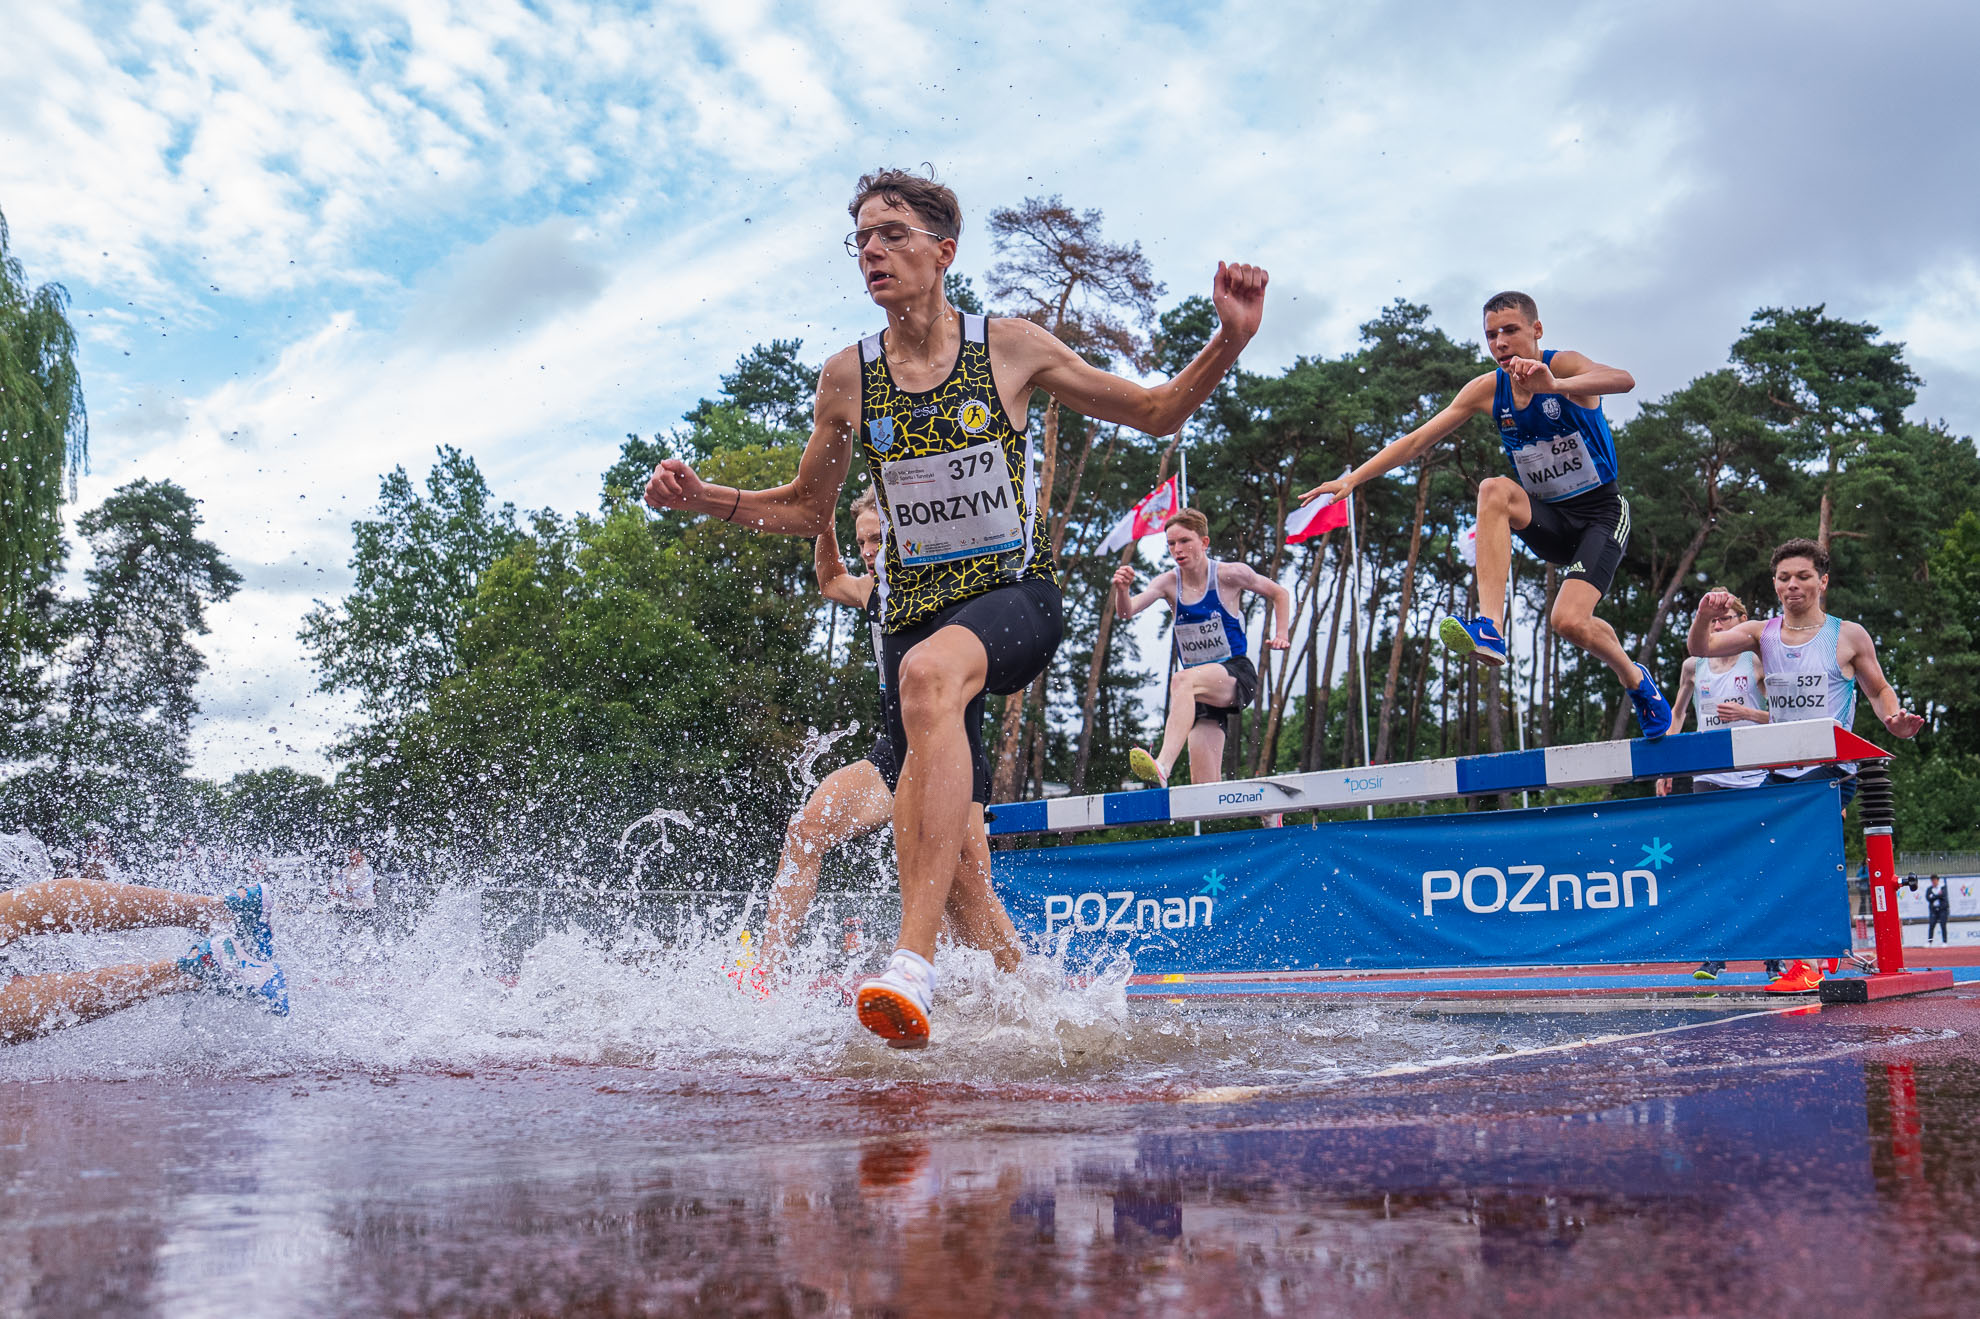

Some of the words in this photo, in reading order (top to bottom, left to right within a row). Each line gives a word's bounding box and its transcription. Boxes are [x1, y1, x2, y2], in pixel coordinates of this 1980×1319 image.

[1551, 438, 1578, 455] 628
[948, 451, 994, 480] 379
[1527, 457, 1582, 484] WALAS
[895, 485, 1008, 526] BORZYM
[1199, 622, 1218, 634] 829
[1182, 636, 1223, 651] NOWAK
[1797, 675, 1822, 687] 537
[1769, 695, 1825, 708] WOŁOSZ
[1350, 775, 1384, 793] posir
